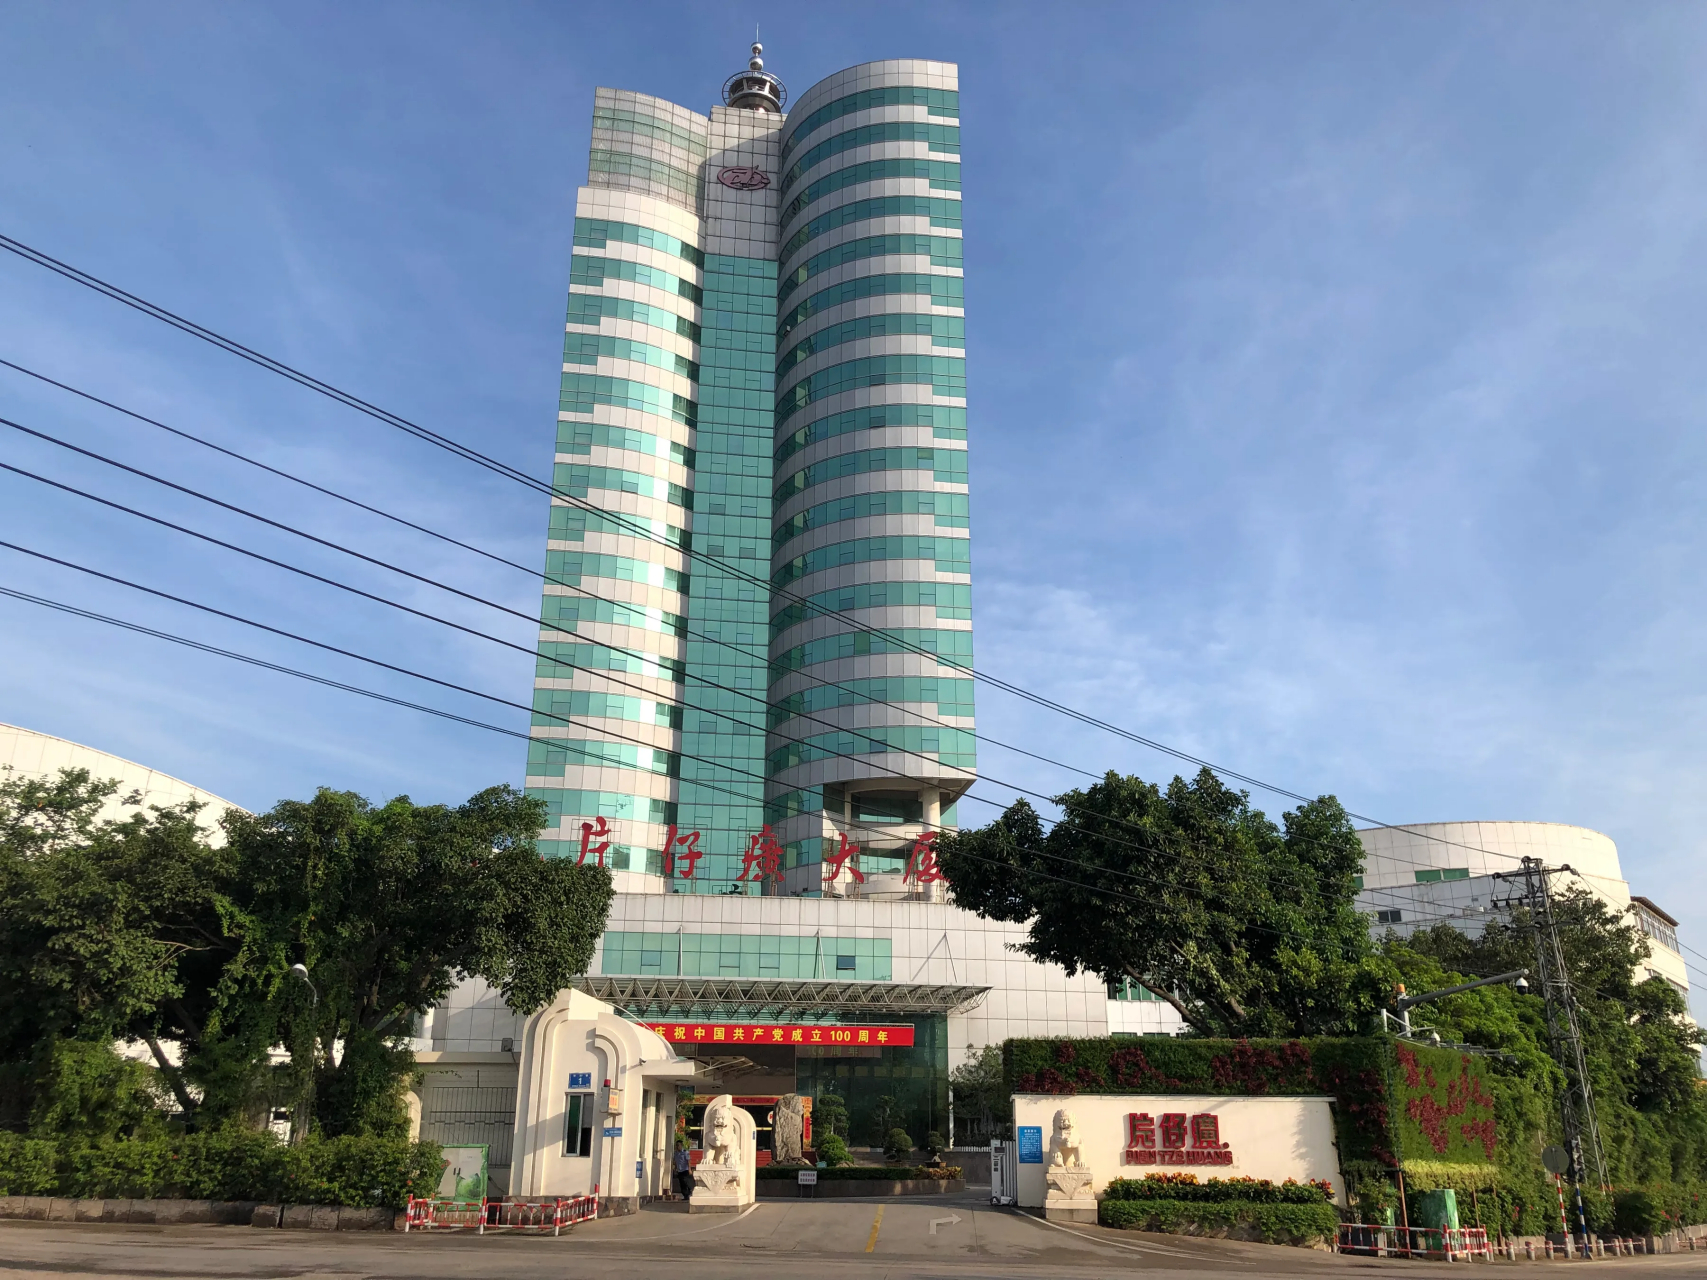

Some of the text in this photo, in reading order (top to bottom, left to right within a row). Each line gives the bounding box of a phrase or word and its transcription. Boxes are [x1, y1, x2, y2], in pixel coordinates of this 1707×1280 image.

[643, 1026, 889, 1044] 庆祝中国共产党成立100周年
[1125, 1150, 1233, 1165] PIEN TZE HUANG
